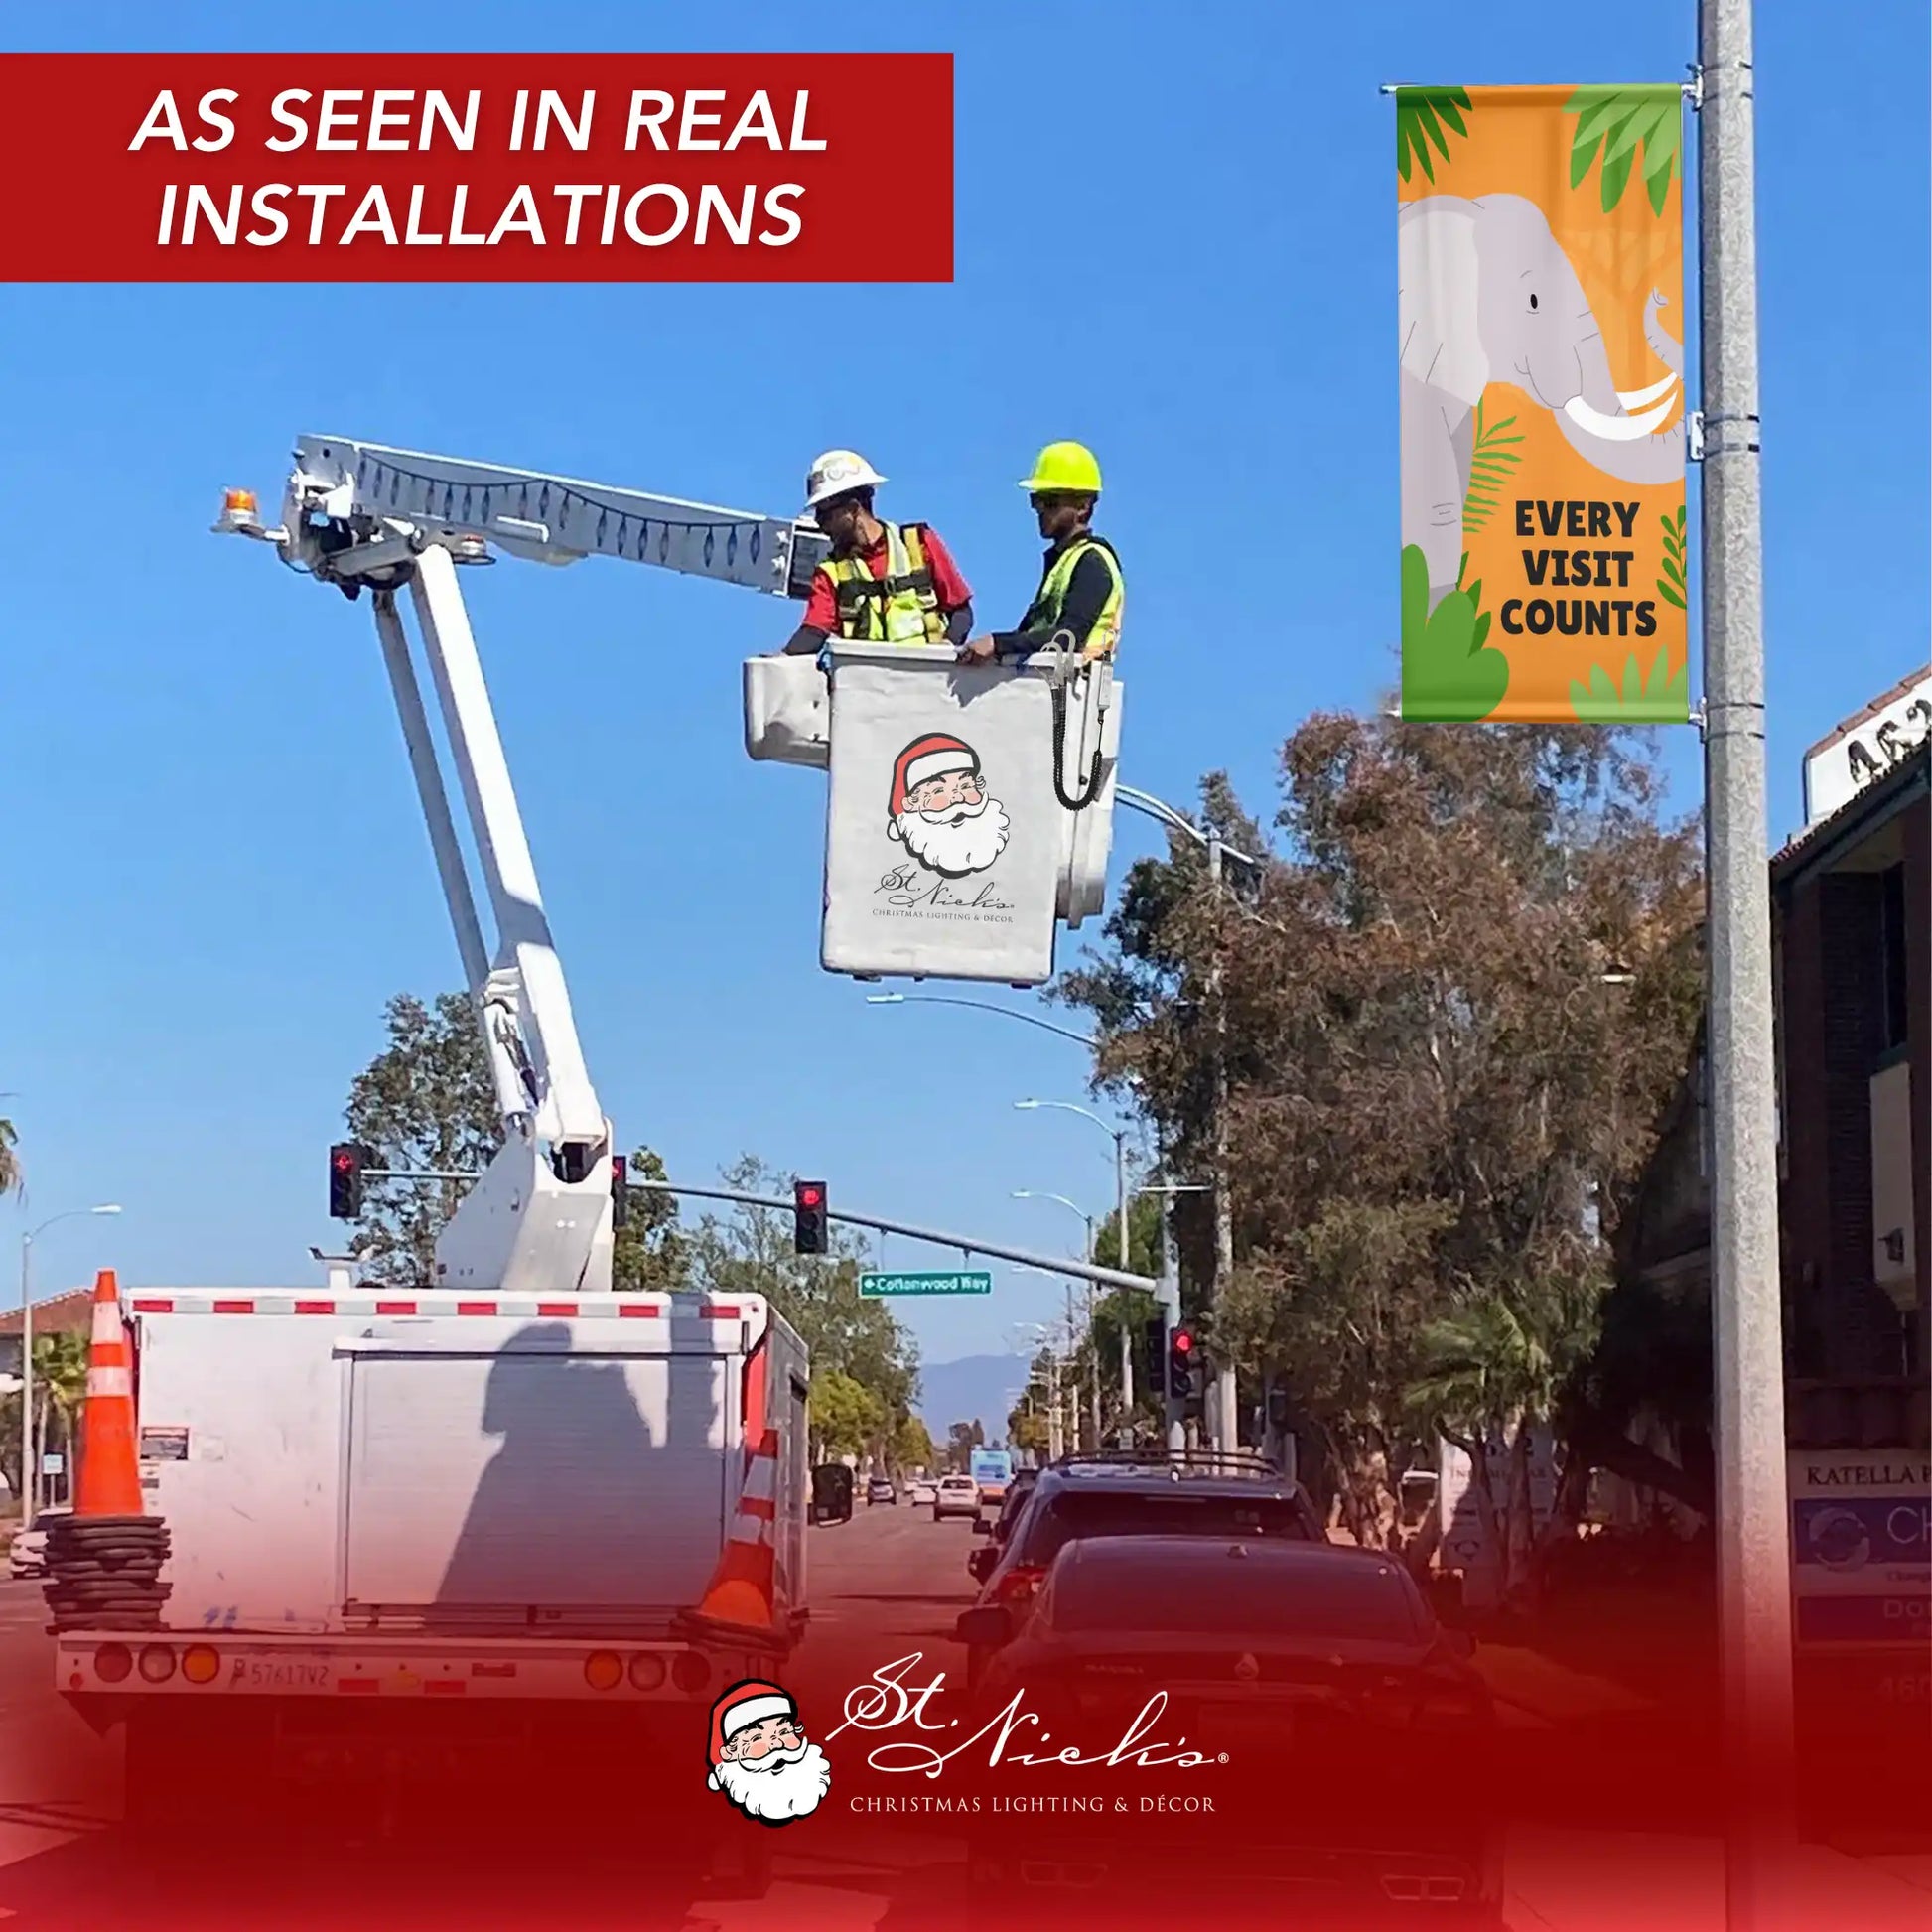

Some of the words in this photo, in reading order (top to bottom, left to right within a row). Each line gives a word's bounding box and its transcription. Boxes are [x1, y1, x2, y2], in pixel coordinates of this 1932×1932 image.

[1516, 500, 1640, 537] EVERY
[1522, 550, 1634, 587] VISIT
[1500, 599, 1657, 636] COUNTS
[874, 863, 921, 894] St.
[872, 908, 923, 918] CHRISTMAS
[926, 911, 971, 921] LIGHTING
[983, 913, 1014, 923] DÉCOR
[876, 1277, 958, 1291] Cottonwood
[960, 1275, 988, 1292] Way
[1807, 1465, 1916, 1485] KATELLA
